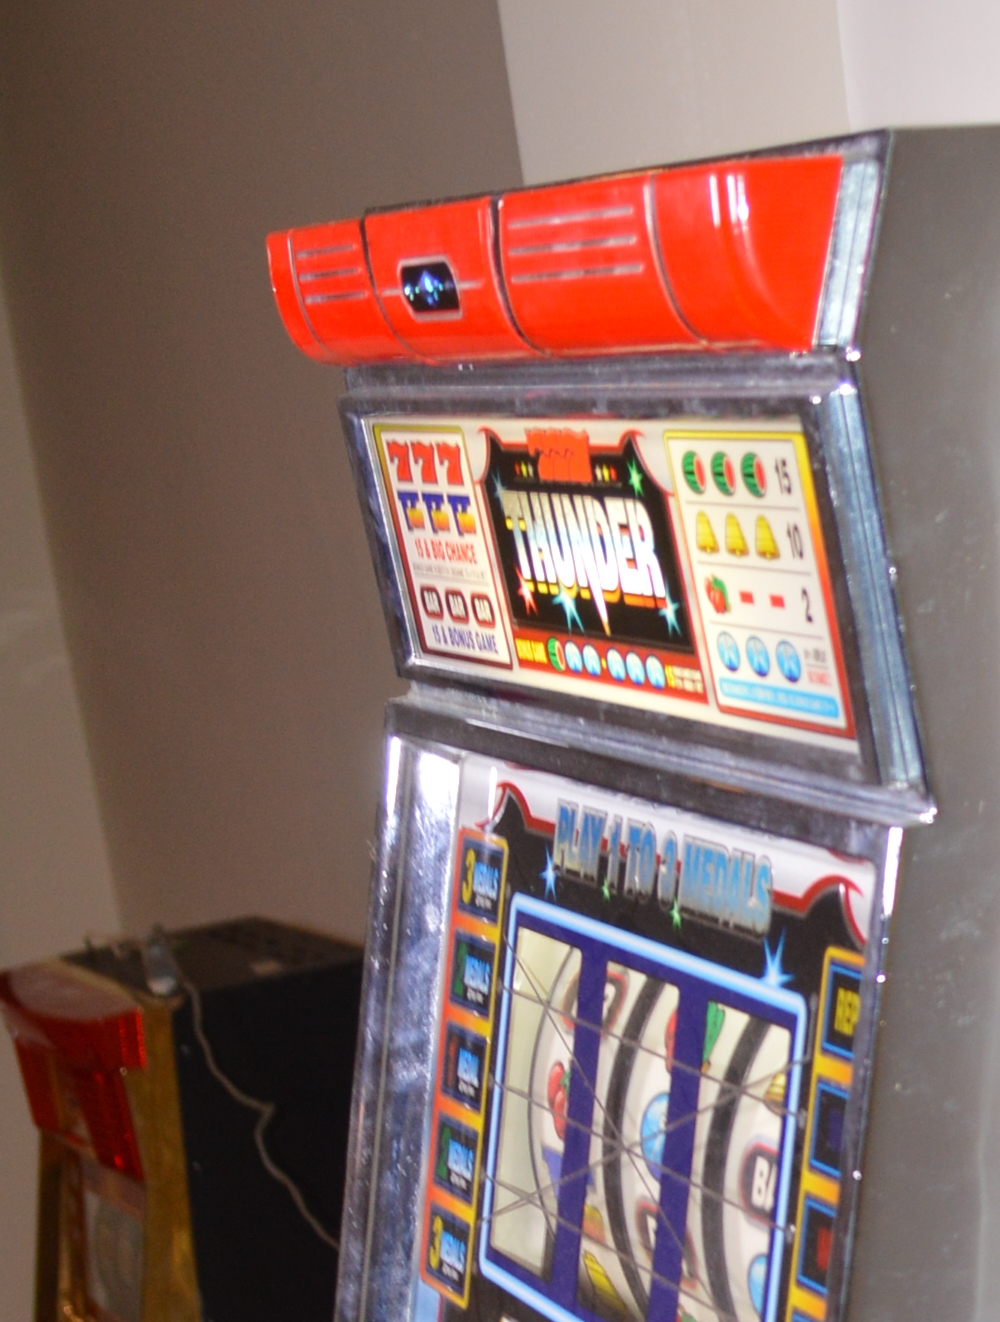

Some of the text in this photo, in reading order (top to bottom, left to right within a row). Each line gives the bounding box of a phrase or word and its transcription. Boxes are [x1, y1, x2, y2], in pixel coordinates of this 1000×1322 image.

[774, 457, 792, 495] 15
[431, 542, 447, 562] BIG
[446, 543, 478, 566] CHANCE
[786, 521, 804, 560] 10
[502, 489, 667, 634] THUNDER
[423, 590, 440, 613] BAR
[448, 595, 466, 617] BAR
[475, 598, 493, 622] BAR
[801, 587, 813, 624] 2
[431, 624, 440, 643] 15
[448, 628, 475, 651] BONUS
[475, 633, 499, 655] GAME
[462, 848, 476, 904] 3
[554, 798, 775, 942] PLAY 1 TO 3 MEDALS
[429, 1215, 443, 1270] 3
